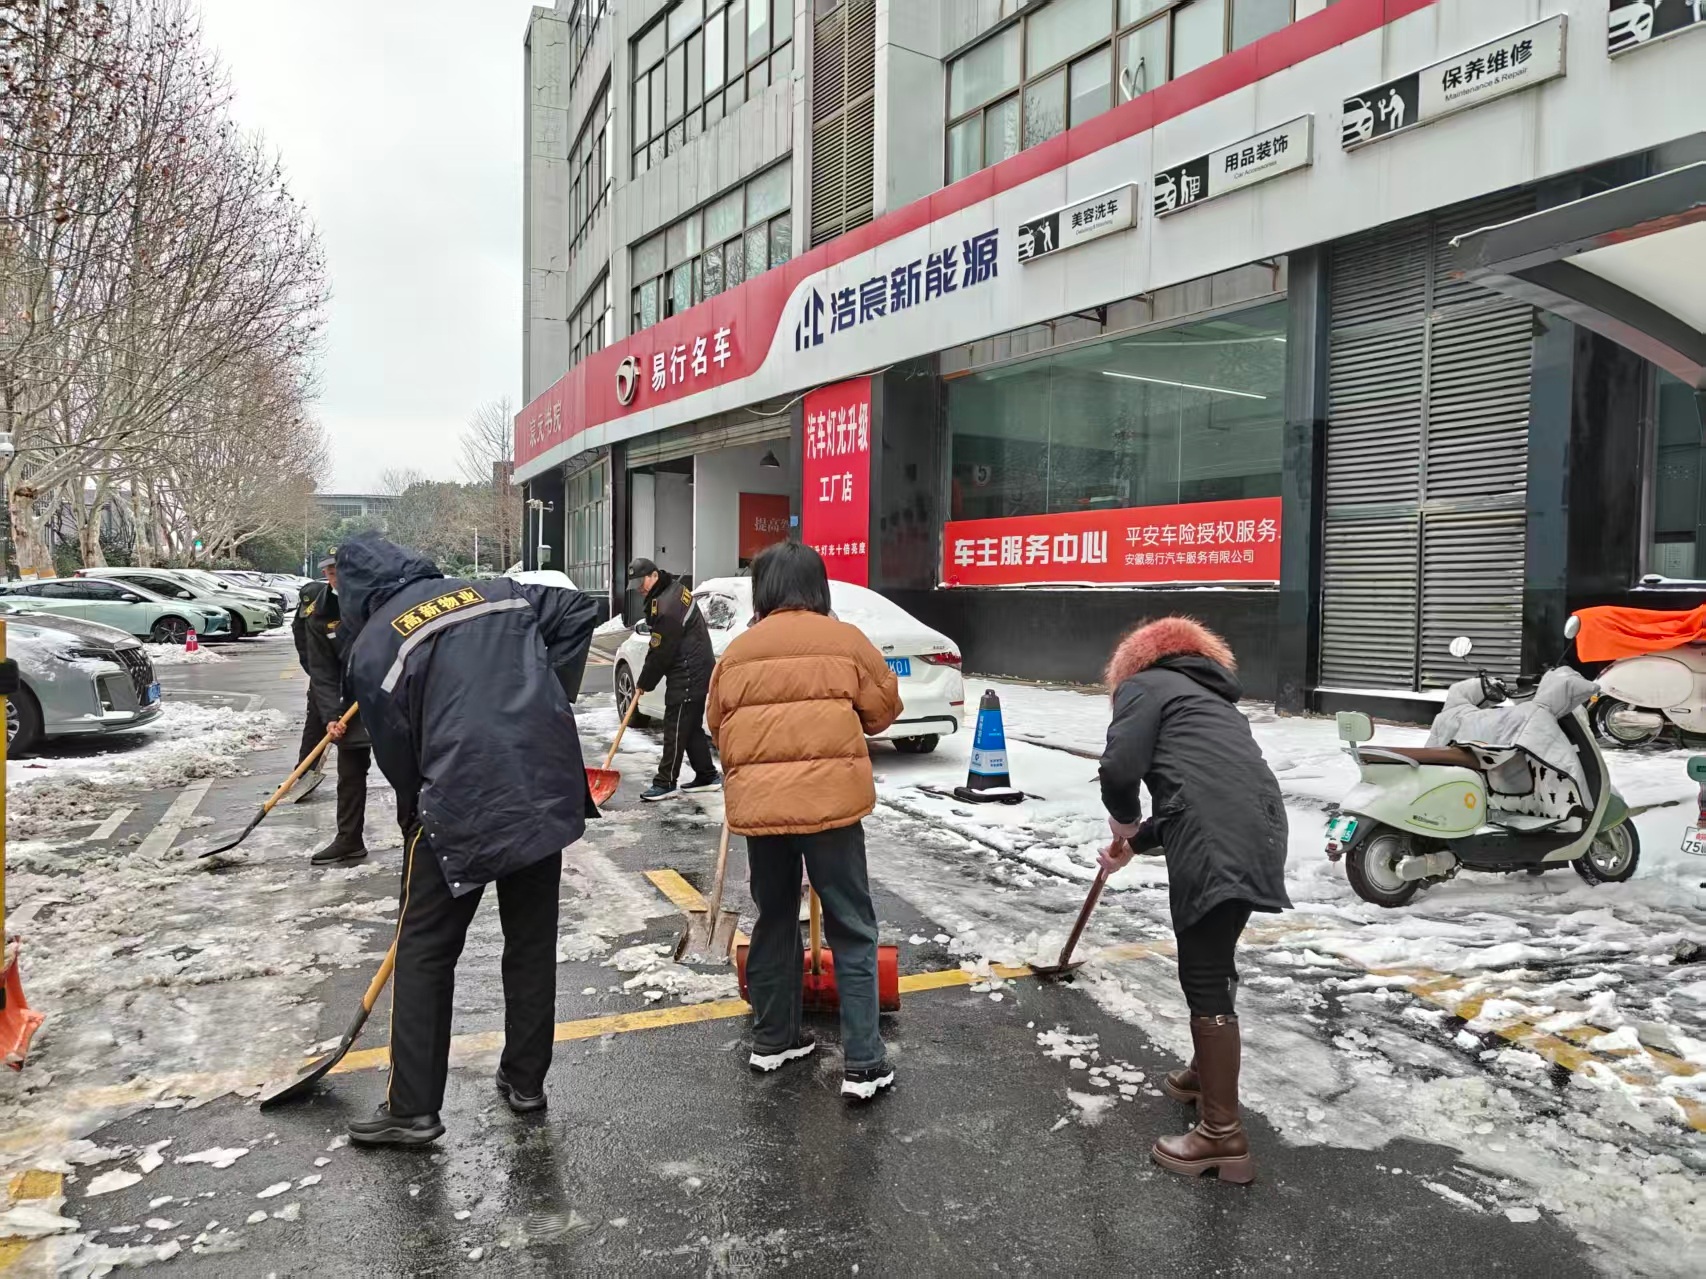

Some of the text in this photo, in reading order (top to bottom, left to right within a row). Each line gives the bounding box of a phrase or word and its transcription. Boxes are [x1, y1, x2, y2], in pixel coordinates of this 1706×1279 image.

[1442, 39, 1533, 91] 保养维修
[1445, 81, 1493, 102] Maintenance
[1502, 67, 1528, 83] Repair
[1225, 134, 1289, 173] 用品装饰
[1071, 199, 1118, 229] 美容洗车
[831, 228, 999, 334] 浩宸新能源
[652, 327, 731, 392] 易行名车
[807, 402, 869, 460] 汽车灯光升级
[819, 471, 853, 503] 工厂店
[809, 542, 866, 556] 升灯光十倍亮度
[954, 530, 1108, 567] 车主服务中心
[1125, 518, 1277, 547] 平安车险授权服务
[1125, 549, 1254, 566] 安徽易行汽车服务有限公司
[399, 590, 479, 630] 高新物业
